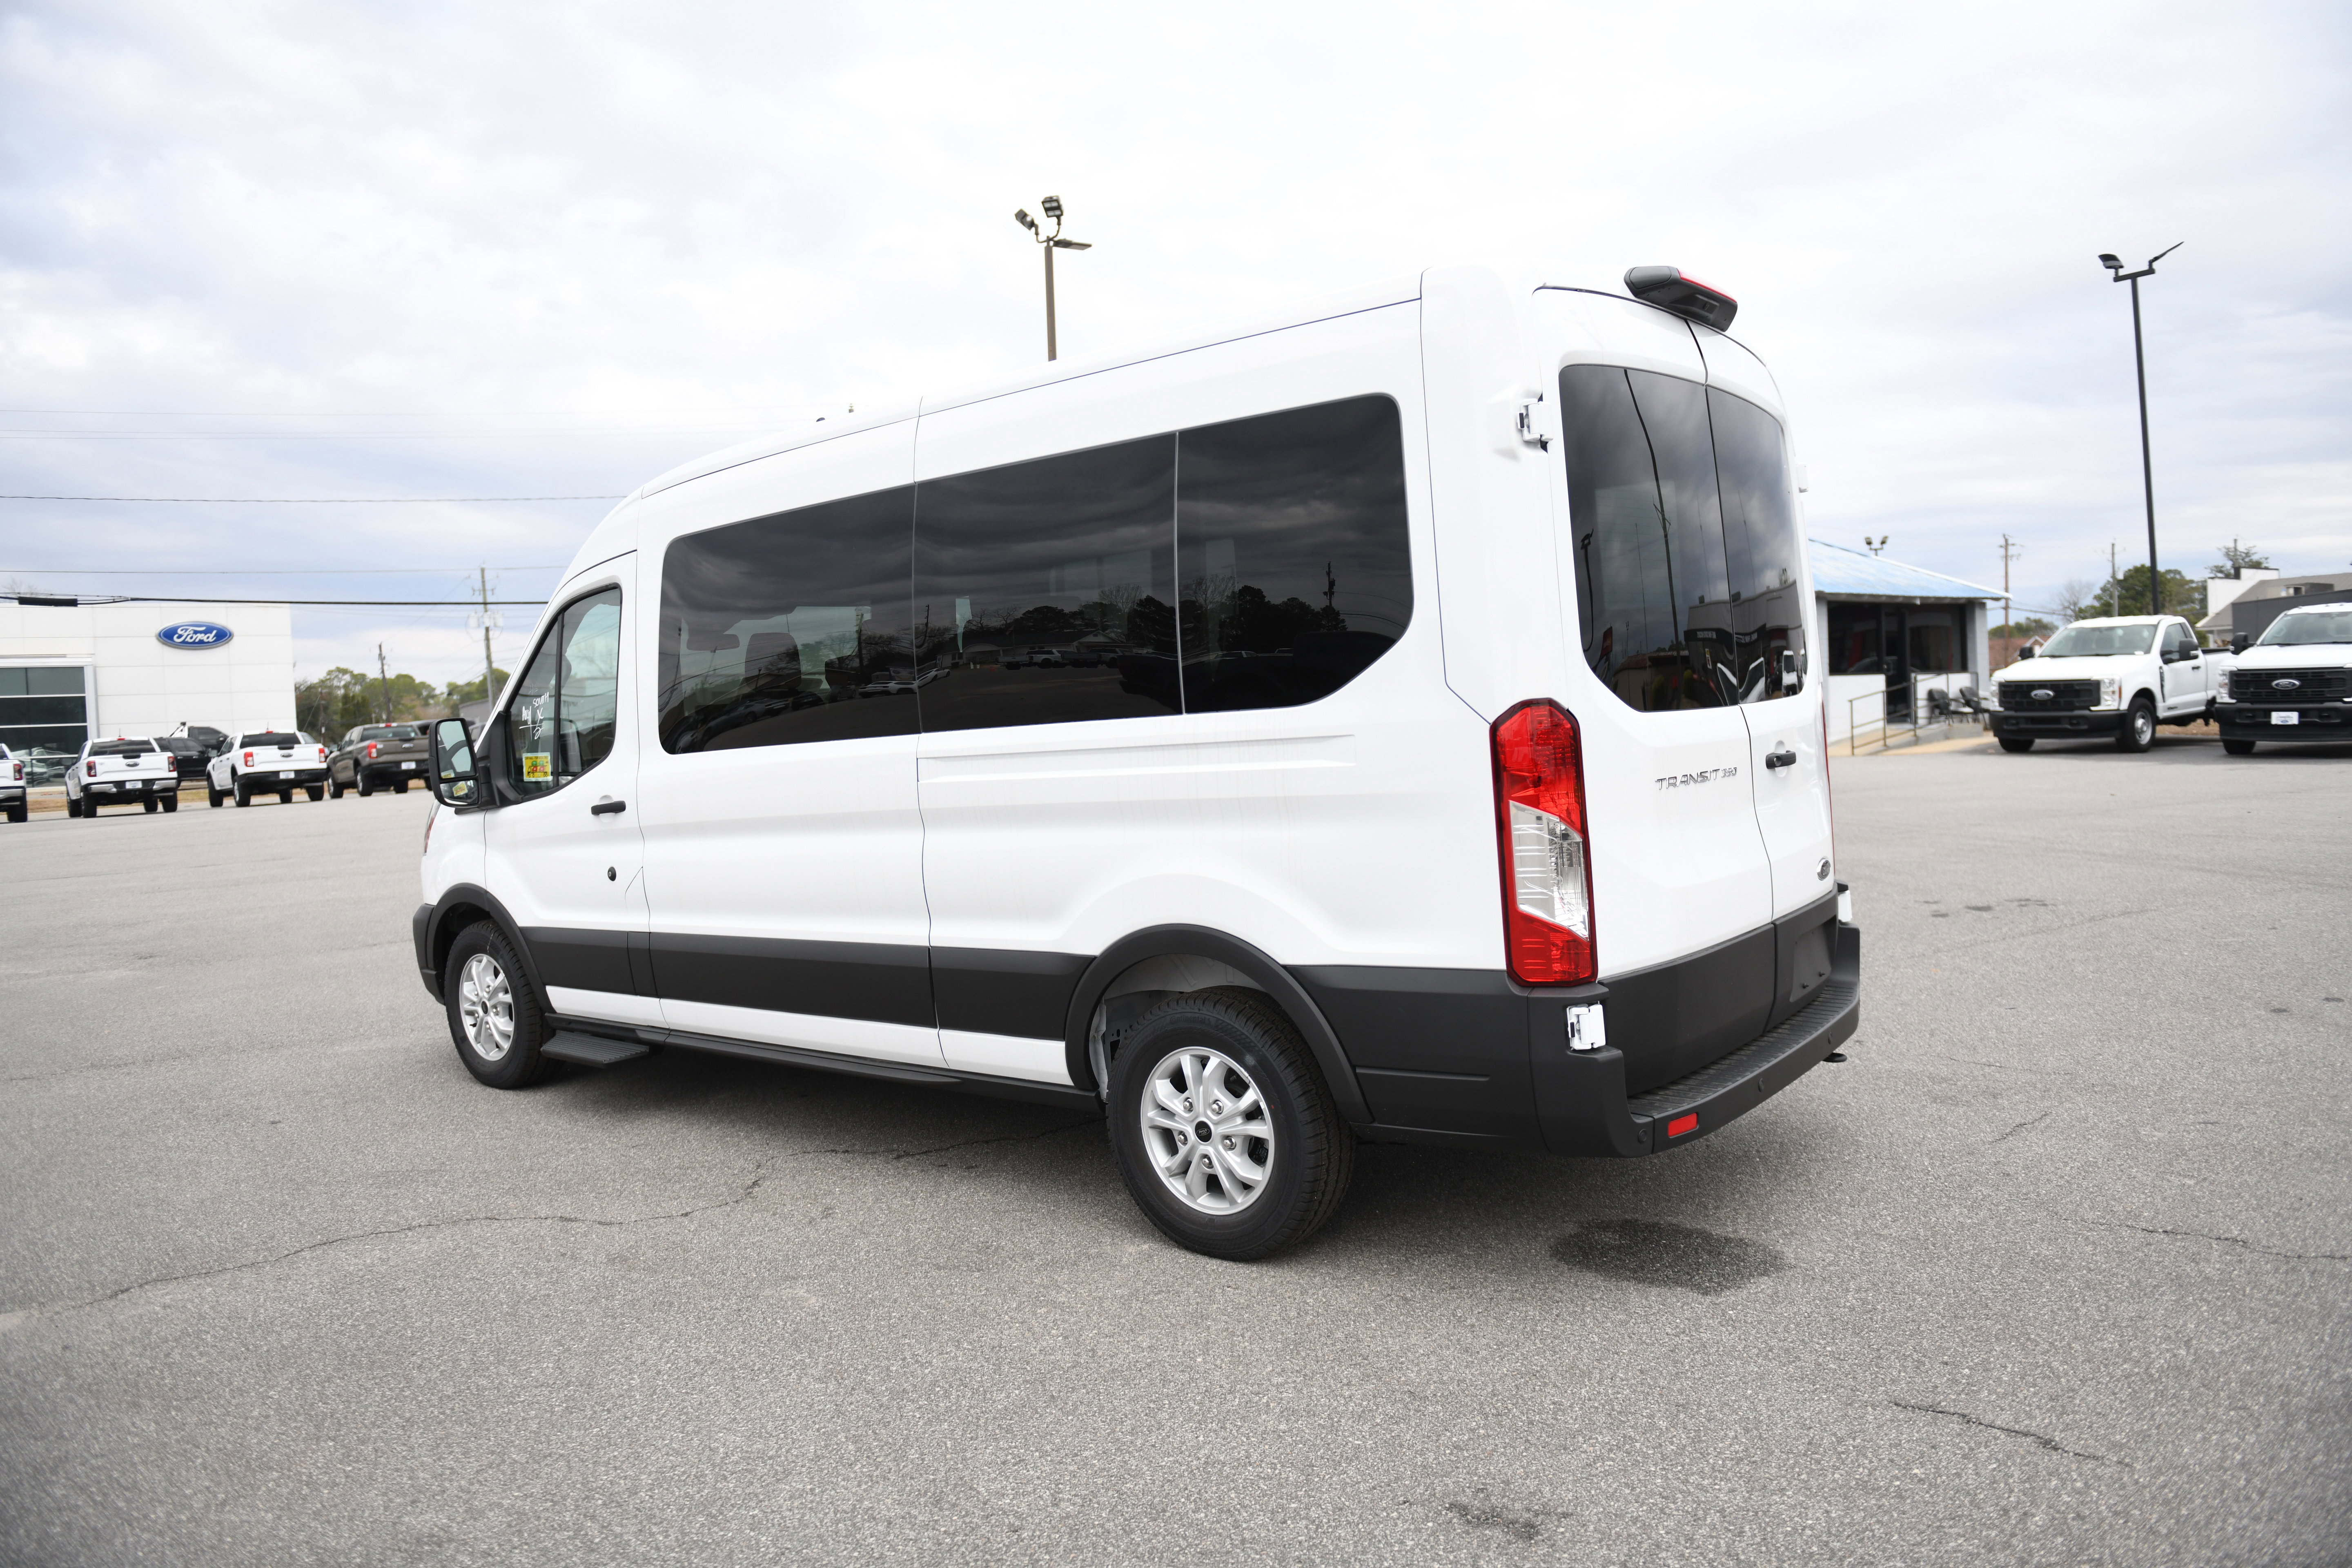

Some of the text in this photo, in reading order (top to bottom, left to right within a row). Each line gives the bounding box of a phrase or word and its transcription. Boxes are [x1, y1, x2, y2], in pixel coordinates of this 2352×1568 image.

[173, 626, 217, 643] Ford
[532, 691, 549, 708] SOUTH
[1655, 768, 1720, 790] TRANSIT
[1170, 1015, 1206, 1025] Continental
